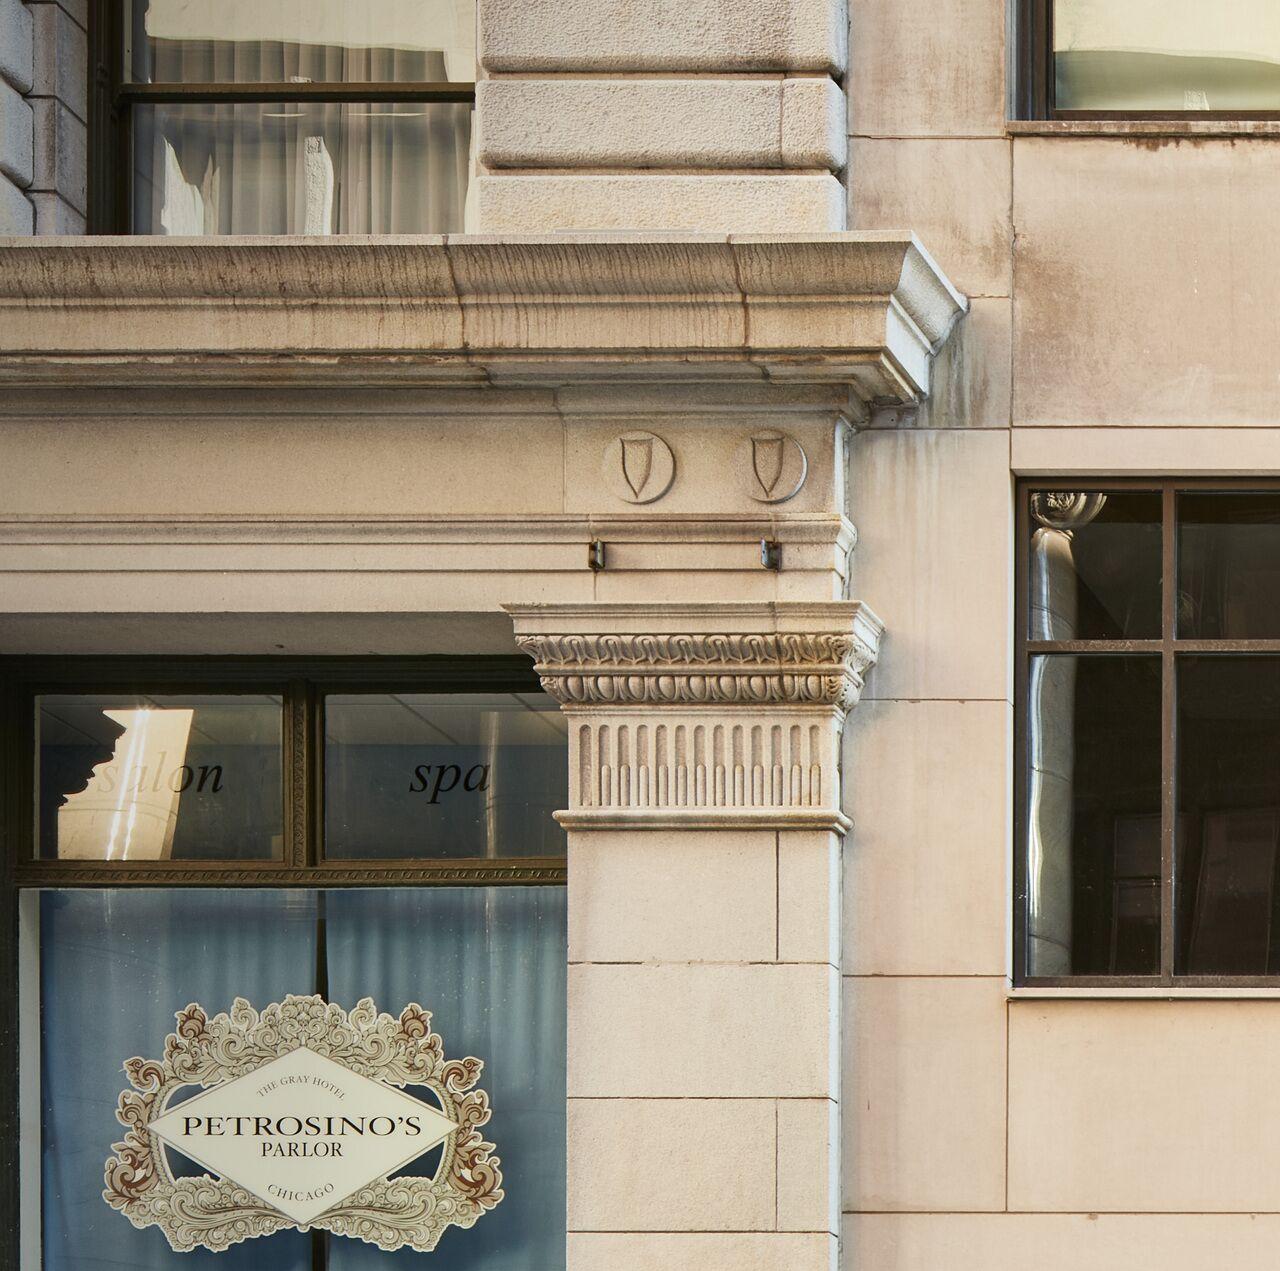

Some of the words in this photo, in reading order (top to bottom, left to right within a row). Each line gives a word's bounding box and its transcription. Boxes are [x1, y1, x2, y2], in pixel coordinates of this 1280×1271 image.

[96, 751, 223, 794] salon
[409, 763, 490, 804] spa
[256, 1081, 277, 1097] THE
[280, 1075, 311, 1086] GRAY
[312, 1077, 345, 1101] HOTEL
[182, 1116, 422, 1137] PETROSINO'S
[261, 1141, 344, 1157] PARLOR
[267, 1183, 335, 1201] CHICAGO
